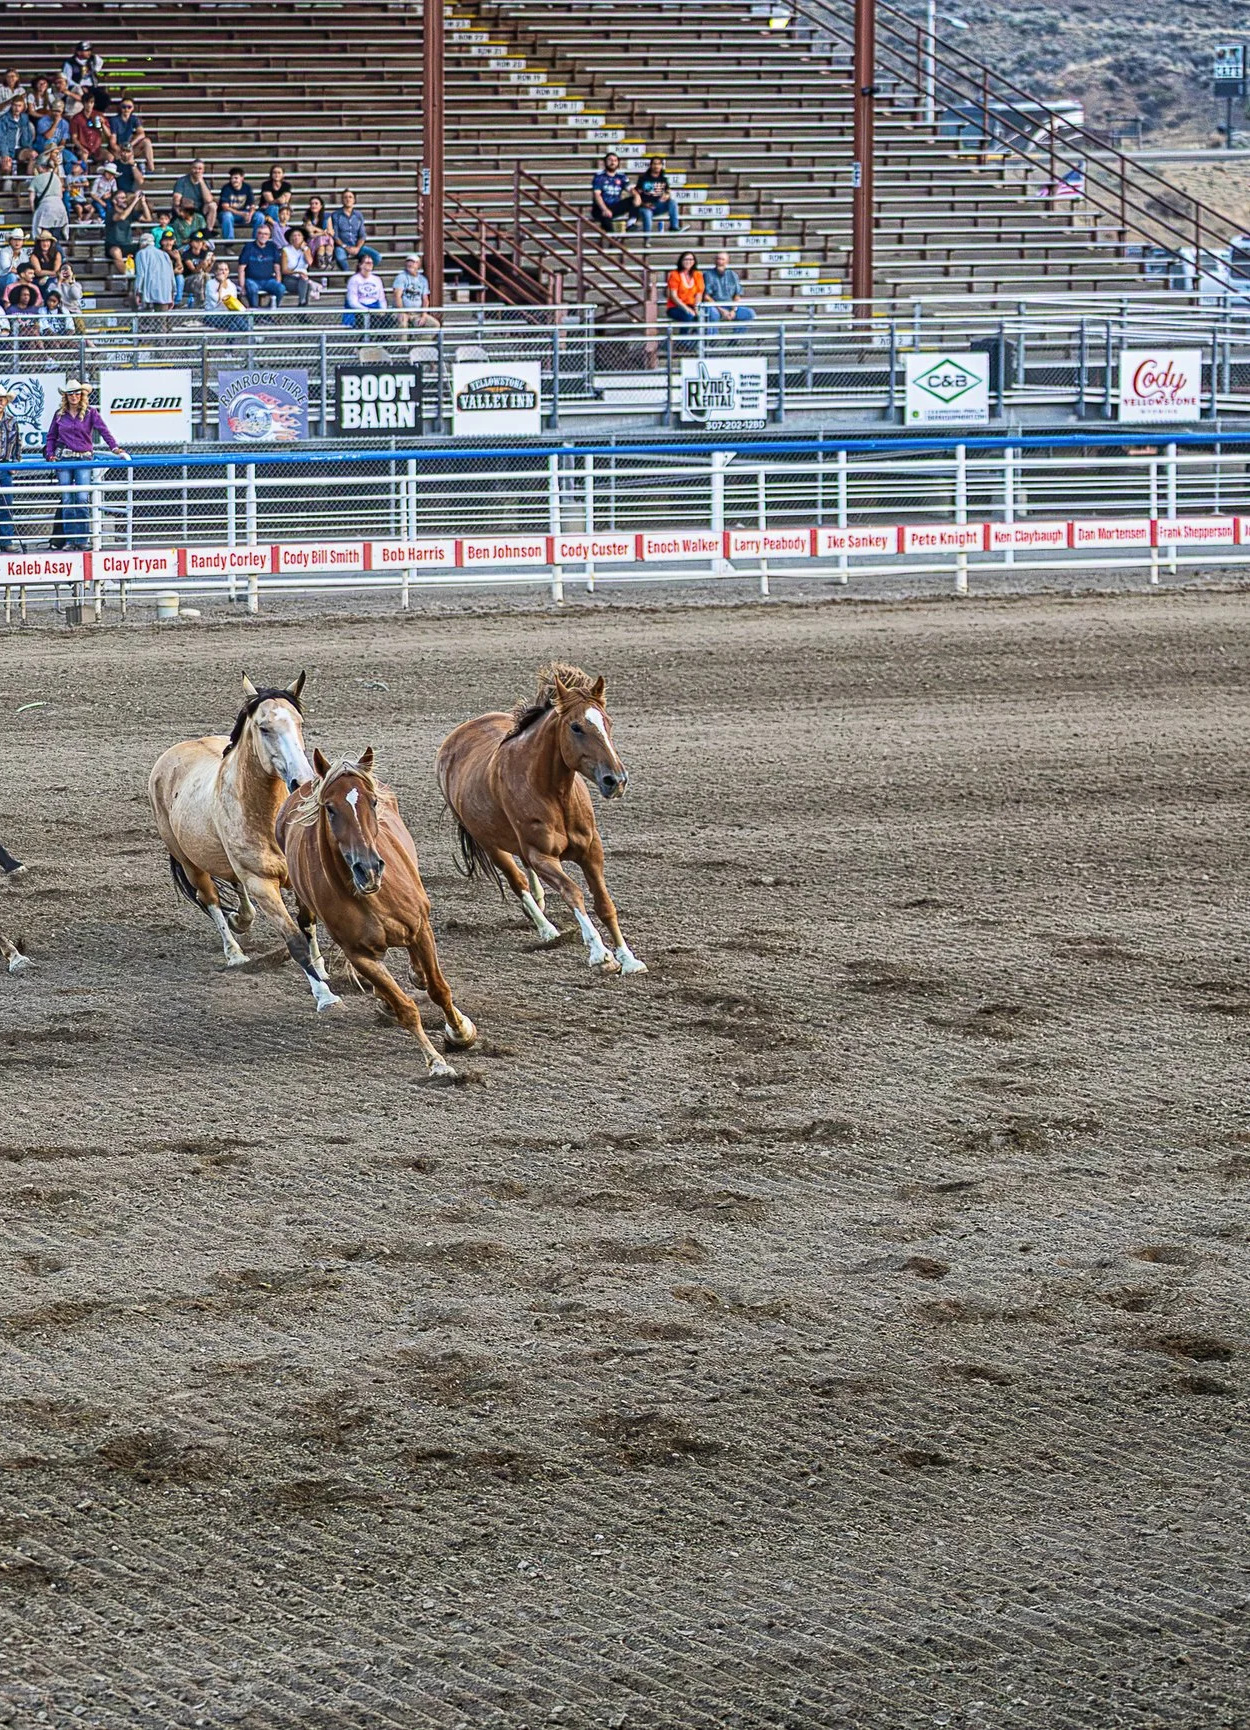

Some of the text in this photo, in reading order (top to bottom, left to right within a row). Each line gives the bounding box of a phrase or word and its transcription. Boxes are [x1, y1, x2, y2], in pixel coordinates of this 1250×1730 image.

[470, 376, 526, 391] YELLOWSTONE
[928, 375, 968, 388] C&B
[1133, 360, 1187, 399] Cody
[219, 372, 309, 408] RIMROCK TIRE
[341, 374, 415, 402] BOOT
[110, 396, 182, 410] can-am
[460, 392, 535, 410] VALLEY INN
[1124, 398, 1197, 406] YELLOWSTONE
[341, 402, 416, 429] BARN
[911, 531, 977, 548] Pete Knight
[995, 529, 1064, 544] Ken Claybaugh
[1078, 527, 1146, 540] Dan Mortensen
[1159, 526, 1181, 539] Frank
[1184, 525, 1232, 541] Shepperson
[648, 539, 719, 554] Enoch Walker
[734, 536, 806, 554] Larry Peabody
[828, 534, 888, 550] Ike Sankey
[284, 549, 360, 566] Cody Bill Smith
[382, 546, 445, 562] Bob Harris
[468, 545, 542, 560] Ben Johnson
[561, 542, 629, 560] Cody Custer
[8, 560, 72, 576] Kaleb Asay
[104, 556, 167, 574] Clay Tryan
[191, 552, 266, 570] Randy Corley
